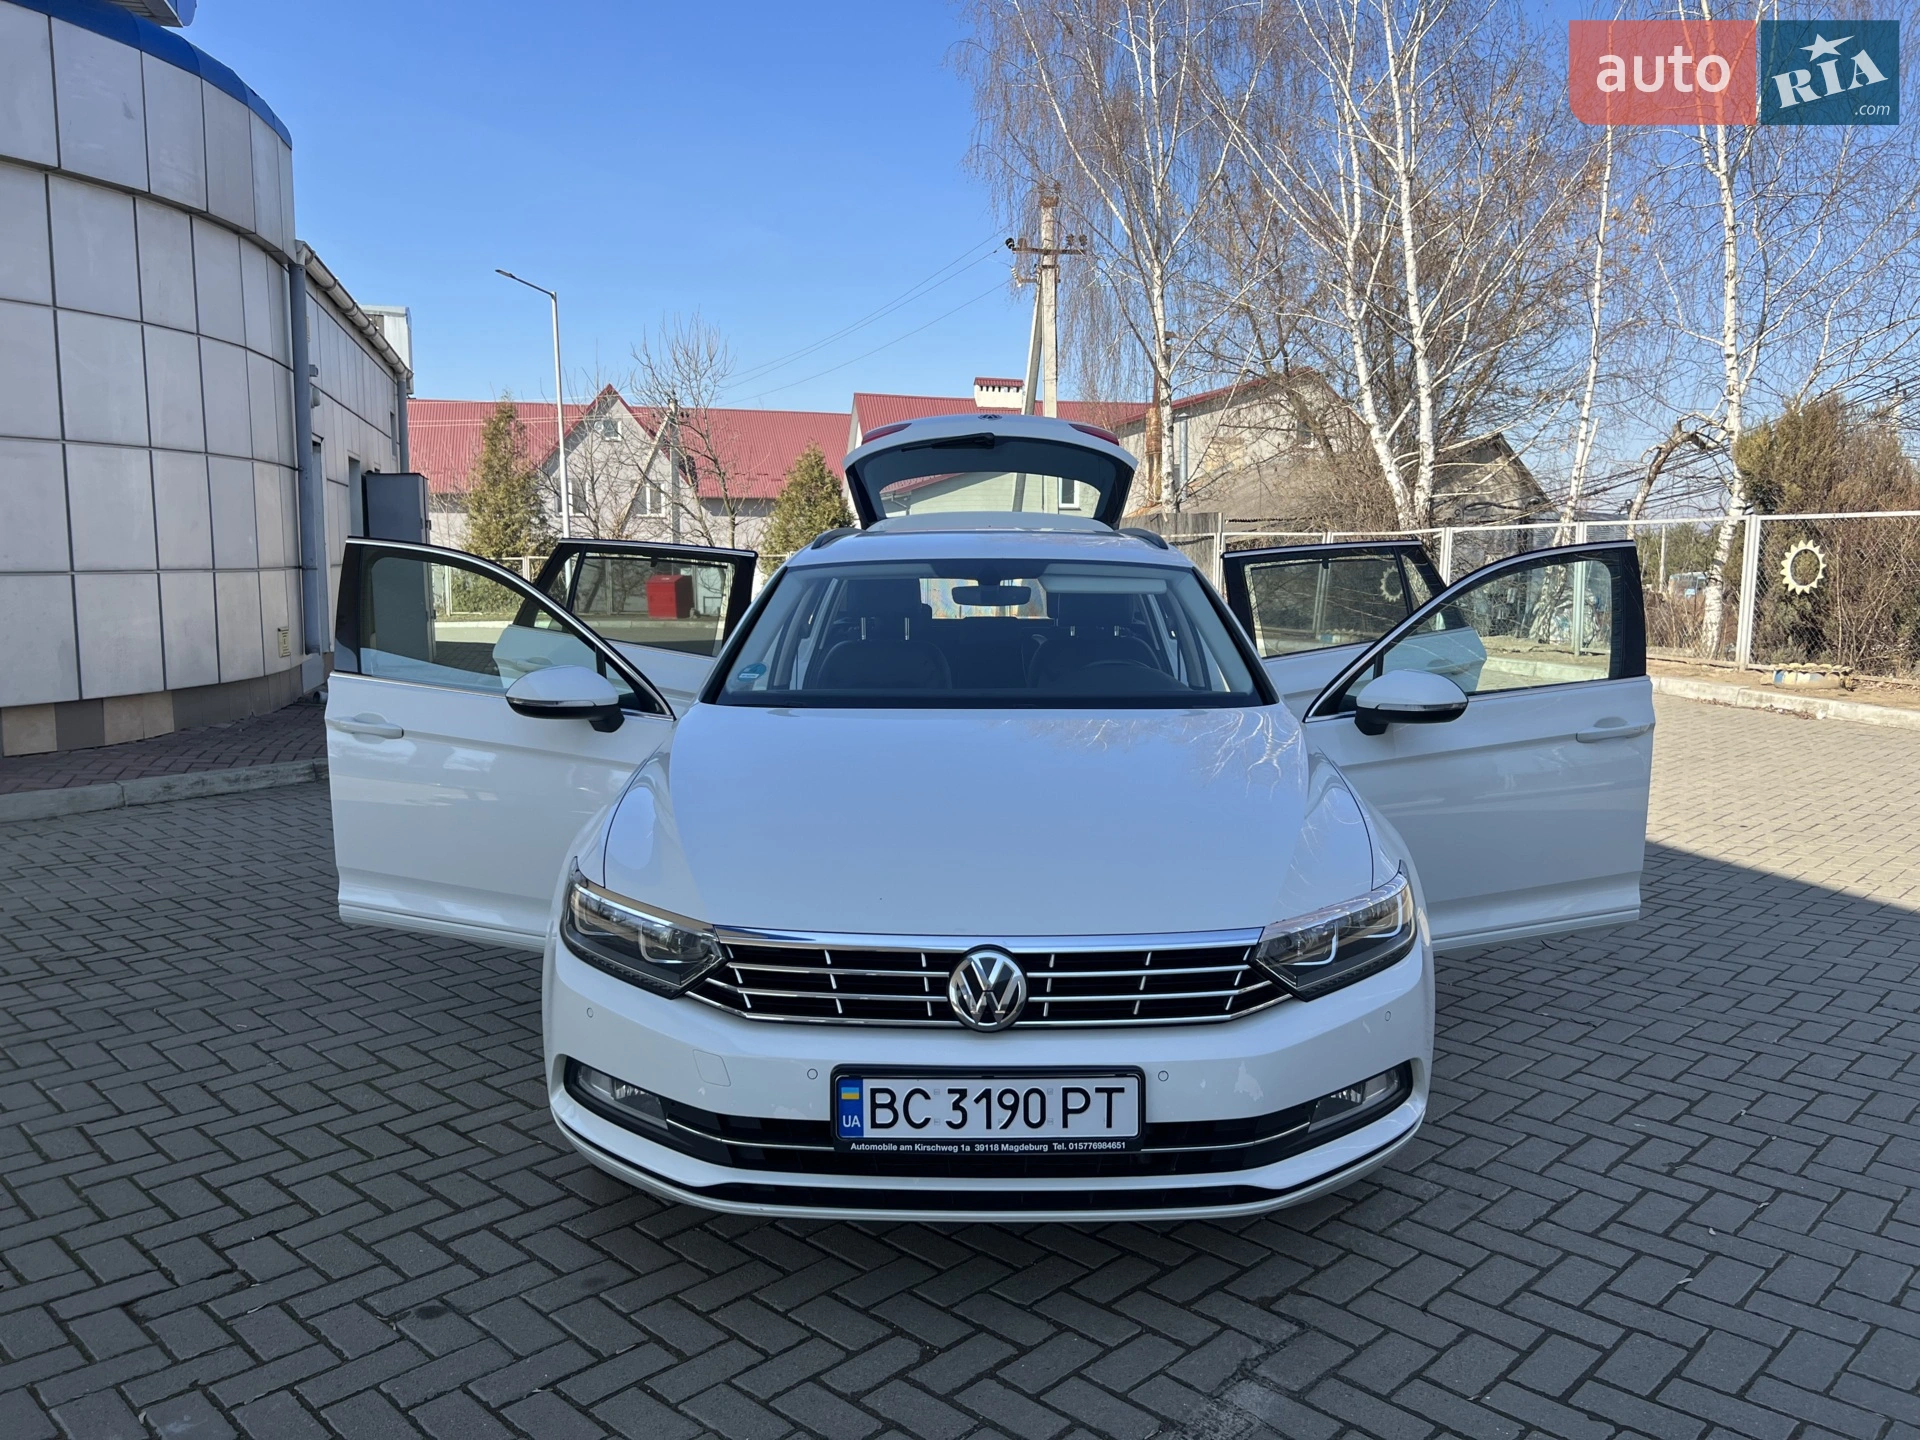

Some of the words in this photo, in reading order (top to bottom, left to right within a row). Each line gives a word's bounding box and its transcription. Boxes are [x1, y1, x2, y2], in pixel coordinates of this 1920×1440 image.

[869, 1087, 931, 1130] BC
[945, 1087, 1047, 1130] 3190
[1061, 1086, 1125, 1129] PT
[842, 1114, 861, 1128] UA
[850, 1142, 897, 1151] Automobile
[915, 1143, 958, 1153] Kirschweg
[960, 1144, 970, 1152] 1a
[974, 1143, 999, 1152] 39118
[1001, 1143, 1048, 1153] Magdeburg
[1052, 1142, 1067, 1151] Tel.
